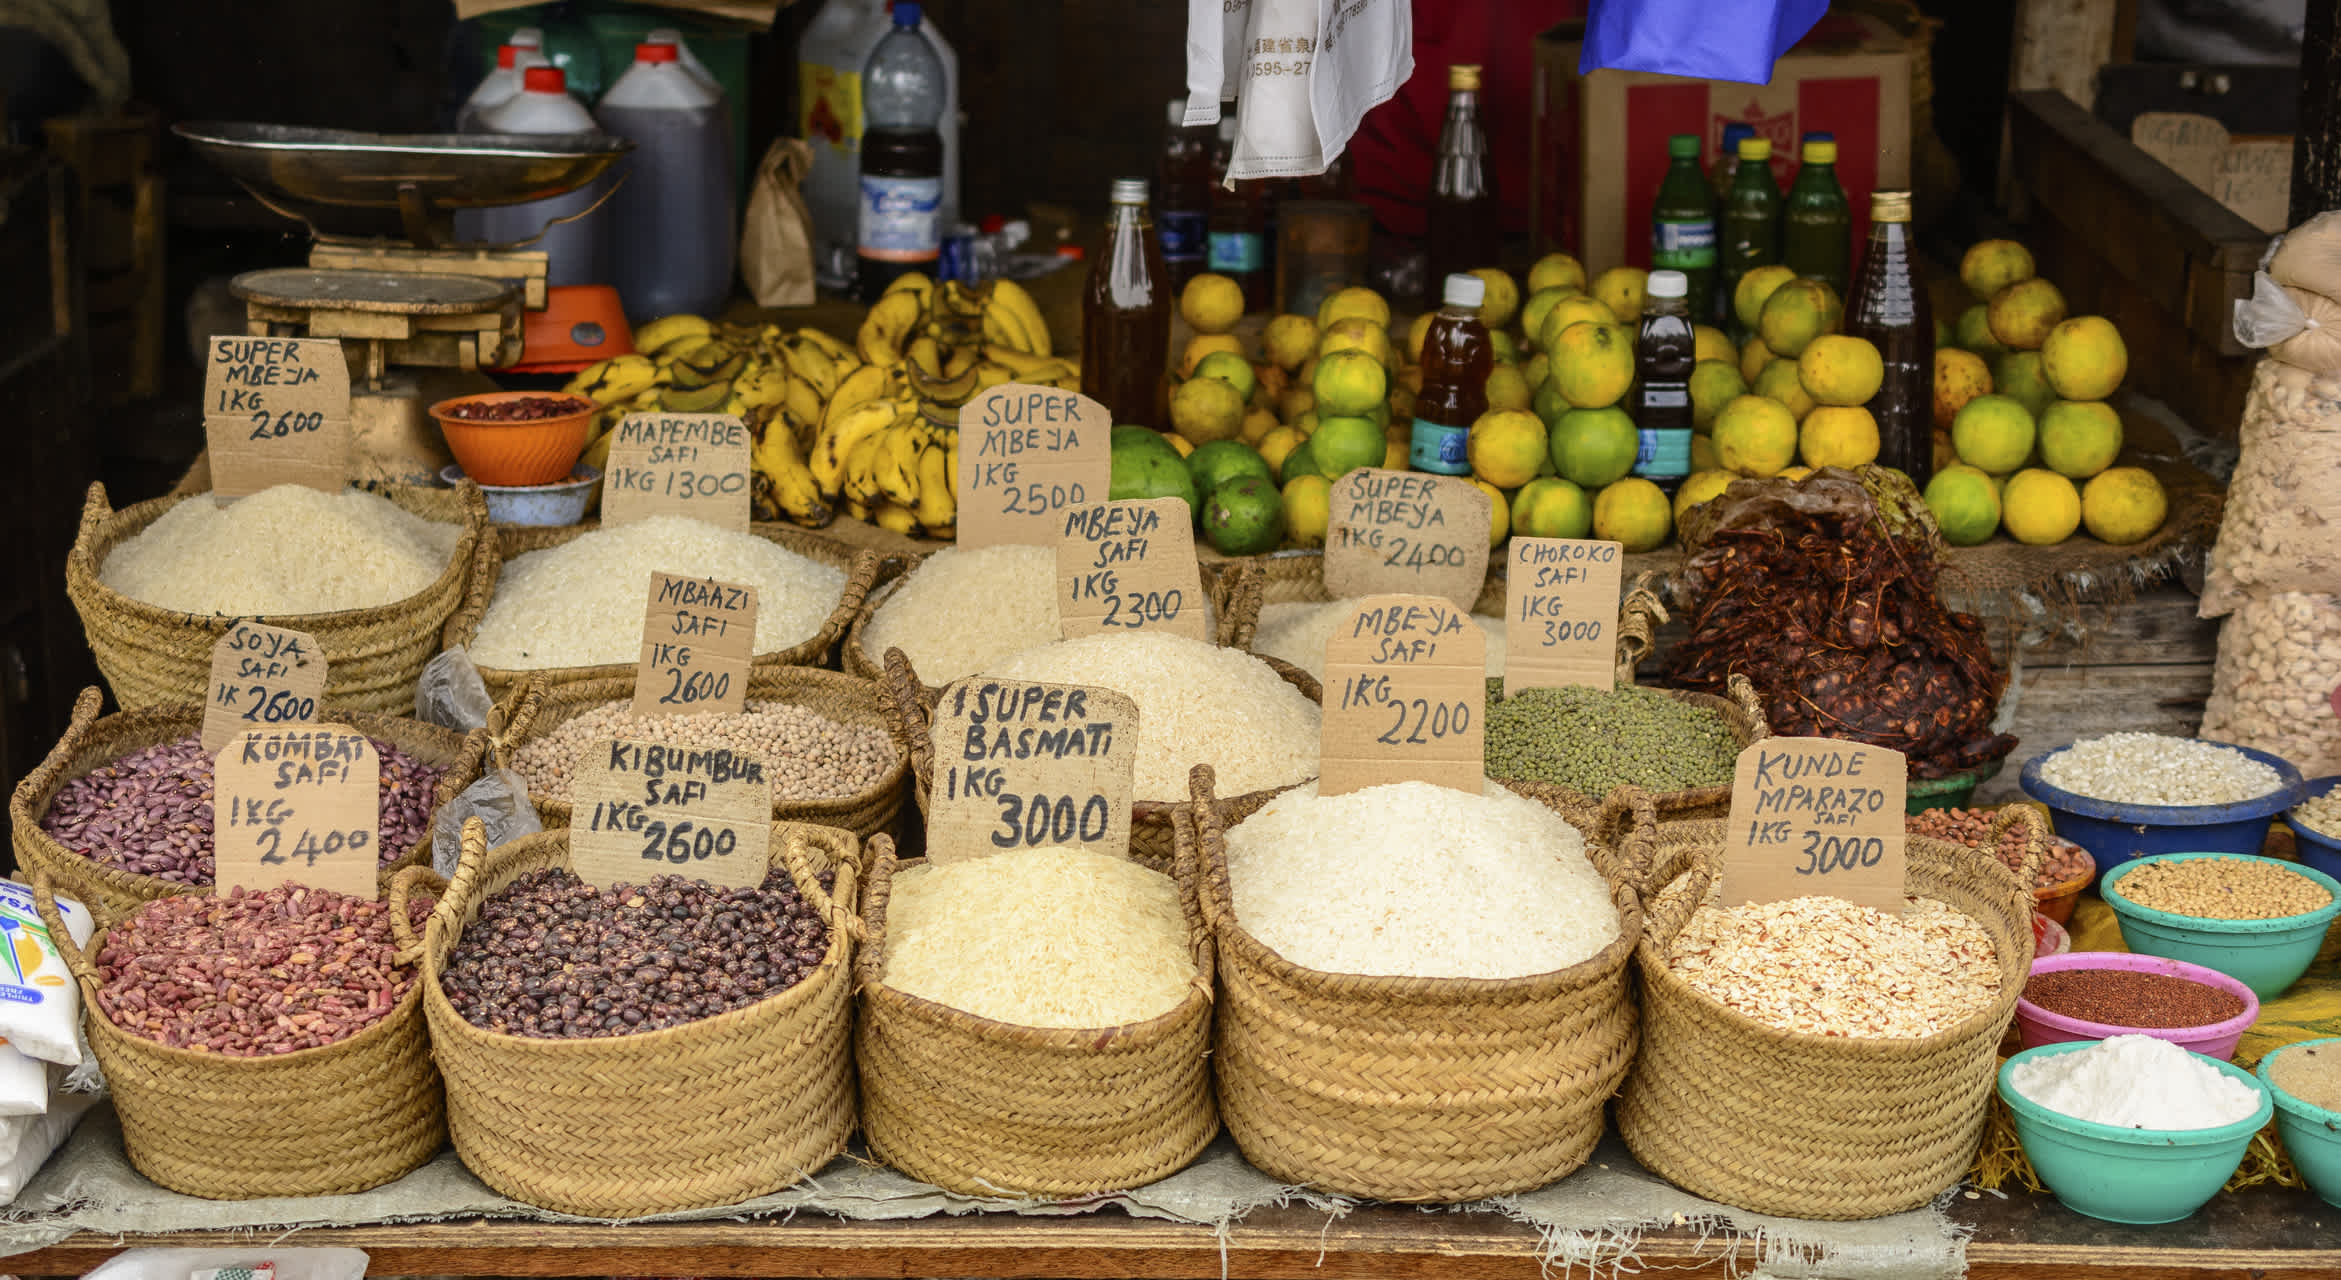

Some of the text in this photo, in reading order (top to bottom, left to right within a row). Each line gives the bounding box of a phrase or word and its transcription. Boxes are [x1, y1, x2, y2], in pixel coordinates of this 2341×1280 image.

[216, 340, 300, 365] SUPER
[219, 389, 264, 412] 1KG
[983, 393, 1082, 427] SUPER
[249, 410, 323, 441] 2600
[619, 419, 743, 446] MAPEMBE
[648, 446, 698, 464] SAFI
[614, 467, 745, 499] 1KG 1300
[972, 462, 1020, 490] 1KG
[1350, 470, 1438, 501] SUPER
[1002, 483, 1086, 516] 2500
[1349, 500, 1445, 529] MBEYA
[1065, 505, 1160, 541] MBEYA
[1340, 527, 1384, 548] 1KG
[1093, 538, 1148, 569] SAFI
[1383, 537, 1465, 575] 2400
[1519, 543, 1616, 565] CHOROKO
[1072, 570, 1119, 602] 1KG
[1534, 566, 1587, 588] SAFI
[658, 577, 749, 610] MBAAZI
[1102, 589, 1183, 629] 2300
[1521, 595, 1563, 622] 1KG
[672, 610, 727, 637] SAFI
[1353, 606, 1463, 638] MBEYA
[1542, 620, 1601, 647] 3000
[229, 626, 306, 660] SOYA
[652, 643, 691, 669] 1KG
[1371, 637, 1436, 664] SAFI
[237, 658, 288, 679] SAFI
[659, 667, 729, 704] 2600
[1342, 673, 1392, 710] 1KG
[241, 686, 314, 723] 2600
[969, 683, 1089, 724] SUPER
[1377, 698, 1470, 745] 2200
[963, 722, 1113, 761] BASMATI
[274, 760, 349, 790] SAFI
[609, 740, 765, 785] KIBUMBUR
[1754, 750, 1867, 790] KUNDE
[645, 778, 707, 806] SAFI
[948, 765, 1007, 800] 1KG
[230, 795, 295, 827] 1KG
[1755, 784, 1884, 815] MPARAZO
[590, 801, 649, 831] 1KG
[991, 793, 1109, 848] 3000
[1813, 812, 1856, 826] SAFI
[256, 827, 369, 867] 2400
[641, 821, 737, 864] 2600
[1747, 820, 1884, 876] 1KG 3000
